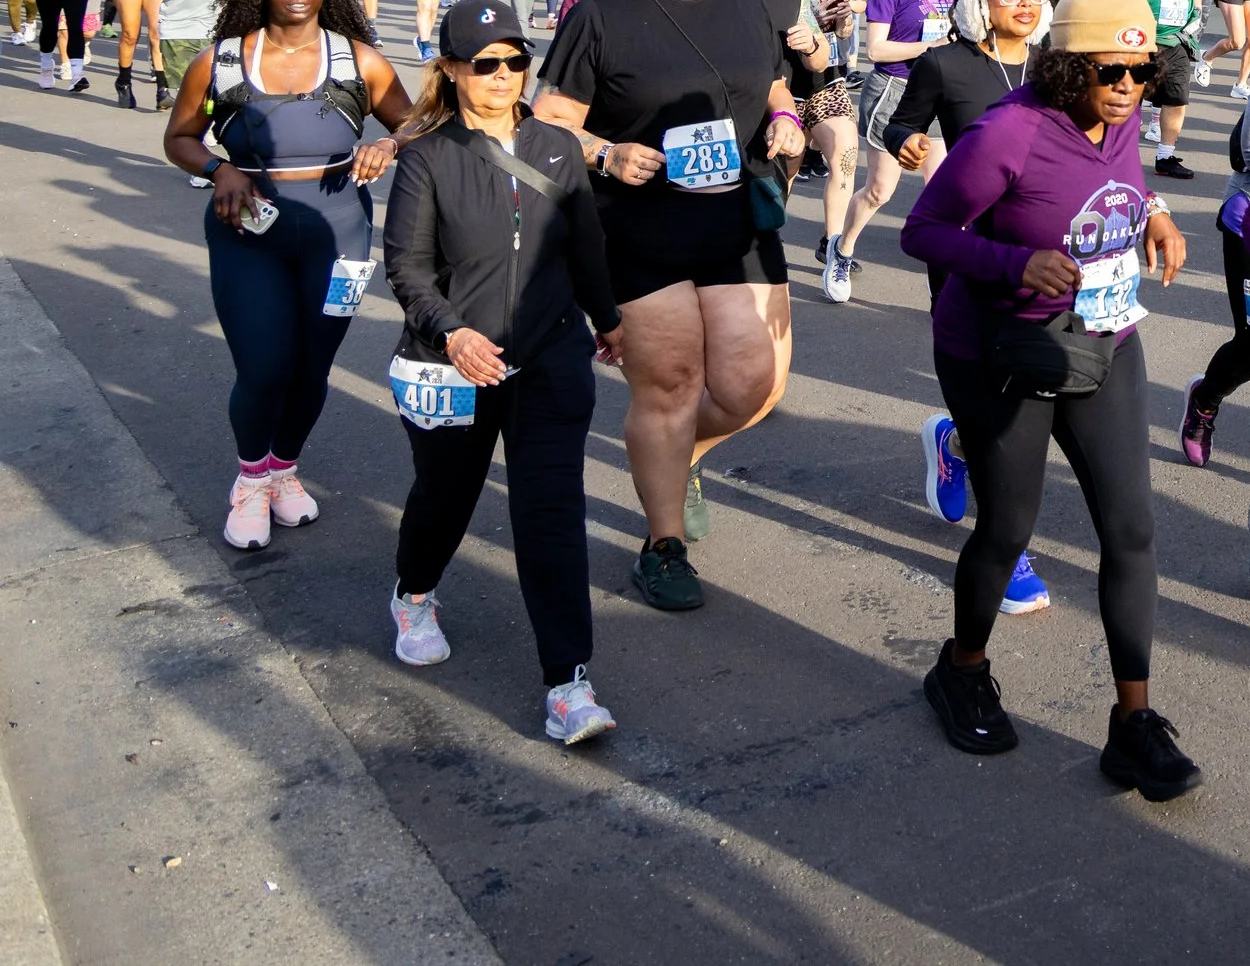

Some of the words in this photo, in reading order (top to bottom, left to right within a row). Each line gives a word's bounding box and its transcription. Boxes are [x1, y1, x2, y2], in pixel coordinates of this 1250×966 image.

[682, 143, 728, 175] 283
[1104, 193, 1128, 208] 2020
[1062, 233, 1097, 246] RUN
[1102, 218, 1148, 242] OAKLAN
[342, 280, 367, 304] 38
[1095, 279, 1132, 319] 132
[404, 384, 454, 416] 401
